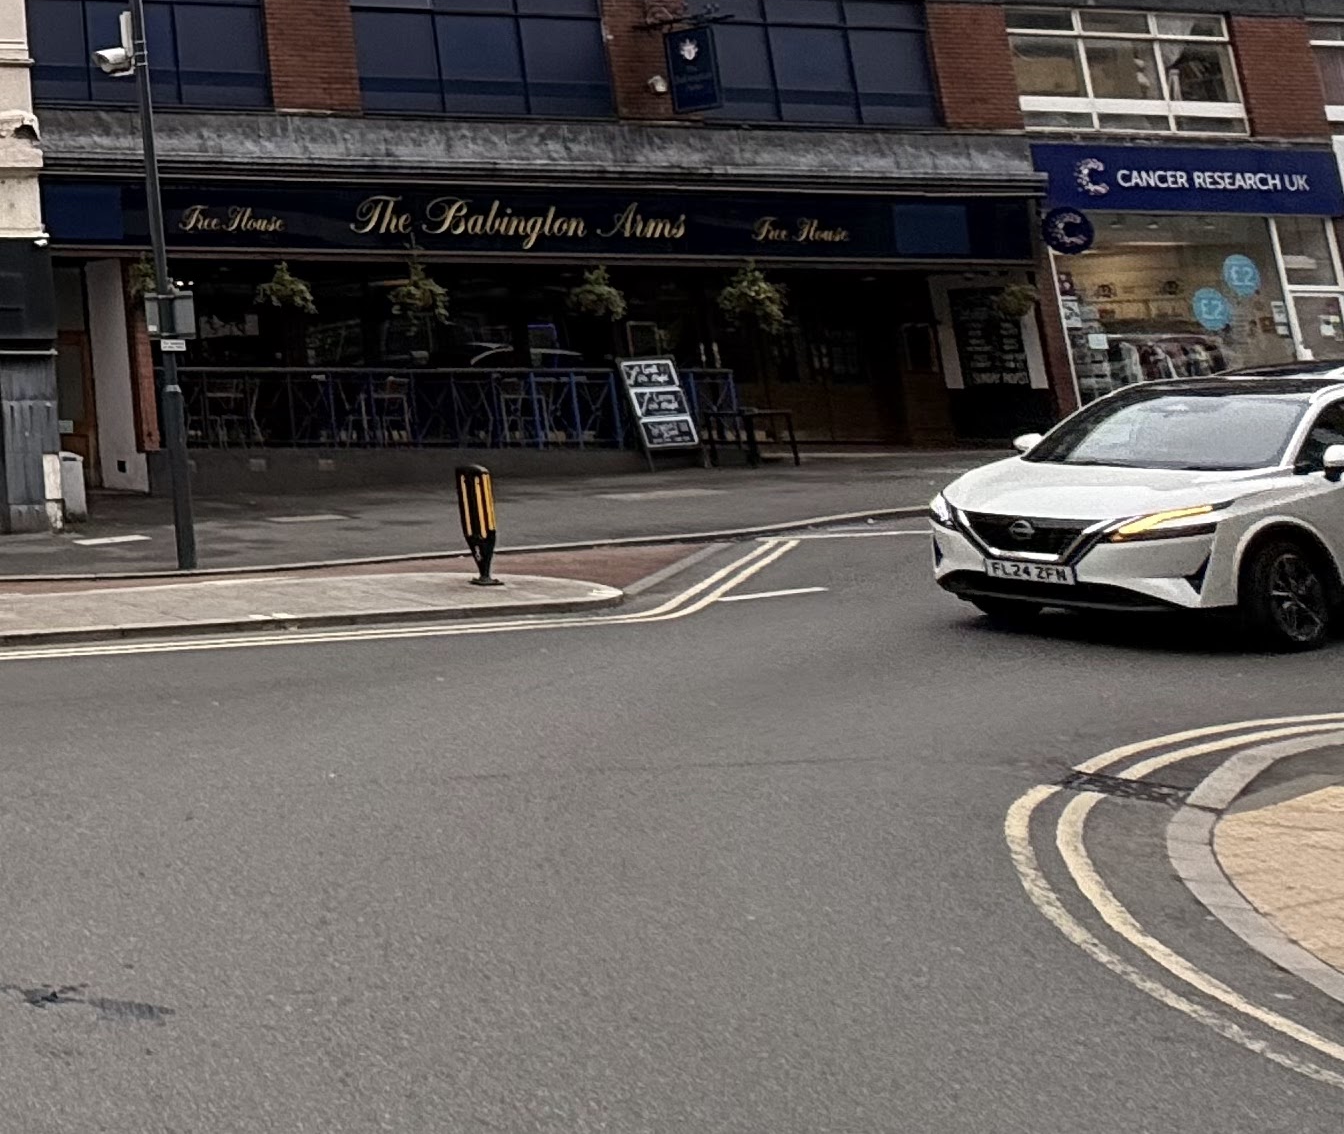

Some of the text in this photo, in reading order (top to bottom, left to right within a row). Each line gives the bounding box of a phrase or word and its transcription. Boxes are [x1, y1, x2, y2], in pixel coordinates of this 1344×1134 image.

[1116, 169, 1310, 192] CANCER RESEARCH UK
[178, 204, 287, 234] Free House
[350, 194, 686, 250] The Babington Arms
[1231, 265, 1256, 287] £2
[1201, 299, 1225, 321] £2
